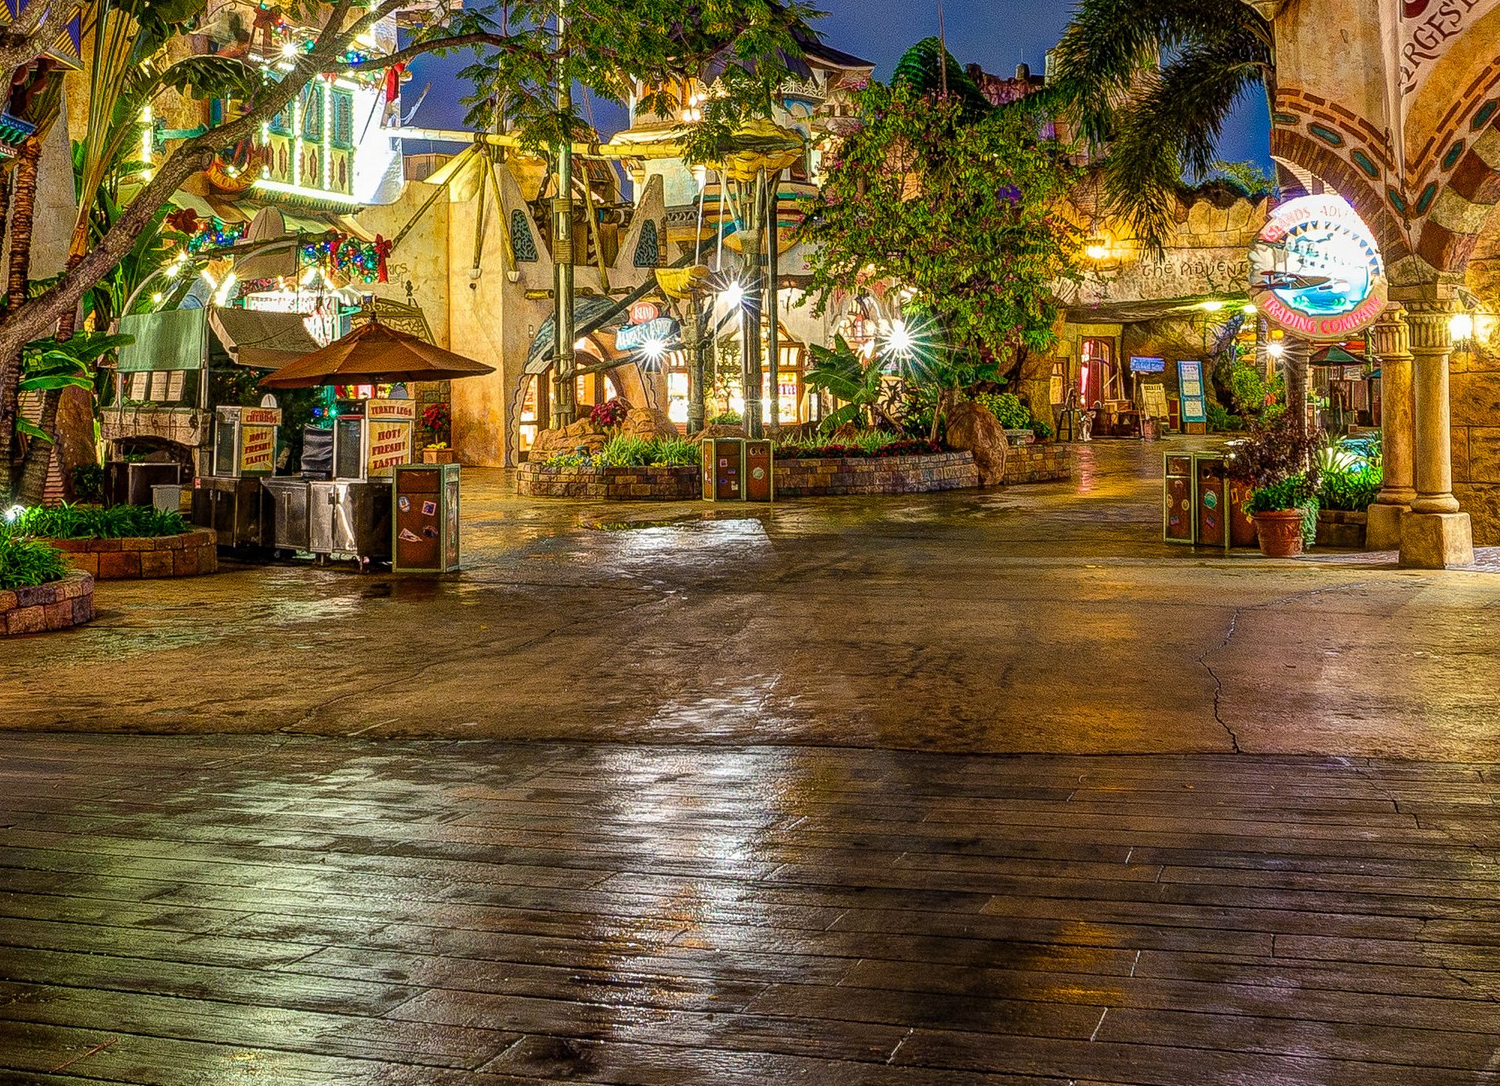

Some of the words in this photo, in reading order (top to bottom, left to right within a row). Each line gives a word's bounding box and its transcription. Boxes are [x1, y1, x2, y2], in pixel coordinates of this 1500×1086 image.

[1263, 296, 1317, 334] TRADING
[1320, 294, 1384, 335] COMPANY
[371, 405, 395, 415] TURKEY
[397, 406, 412, 416] LEGS
[378, 429, 400, 441] HOT!
[372, 442, 406, 456] FRESH!
[373, 455, 404, 470] TASTY!
